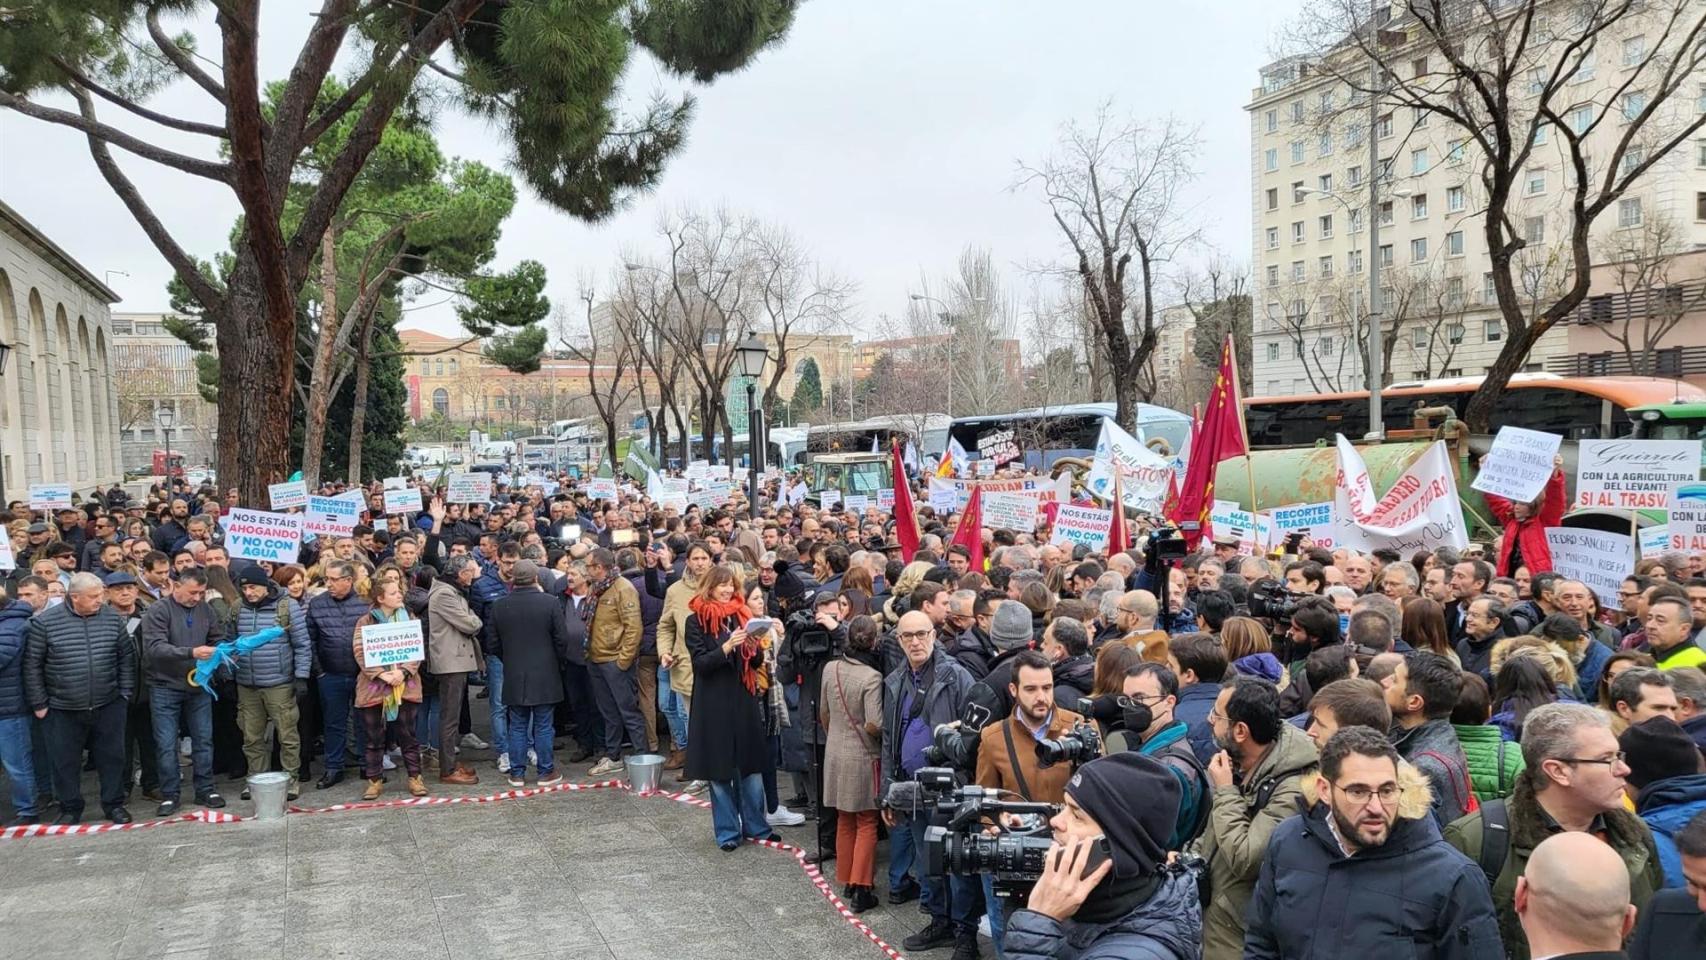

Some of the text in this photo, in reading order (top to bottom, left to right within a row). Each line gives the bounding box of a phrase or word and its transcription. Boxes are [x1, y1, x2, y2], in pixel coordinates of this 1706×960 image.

[1582, 472, 1694, 481] CON LA AGRICULTURA
[1024, 480, 1036, 490] EL
[1604, 482, 1621, 490] DEL
[311, 498, 356, 508] RECORTES
[1581, 492, 1668, 507] SI AL TRASV
[312, 505, 355, 515] TRASVASE
[1061, 509, 1080, 518] NOS
[1276, 505, 1330, 520] RECORTES
[233, 513, 297, 528] NOS ESTÁIS
[1276, 515, 1330, 529] TRASVASE
[1672, 512, 1693, 521] CON
[1057, 518, 1109, 531] AHOGANDO
[229, 523, 299, 539] AHOGANDO
[1067, 529, 1082, 538] NO
[1083, 532, 1104, 541] CON
[232, 535, 293, 550] Y NO CON
[1673, 535, 1685, 549] SI
[1691, 536, 1706, 550] AL
[242, 547, 278, 559] AGUA
[366, 639, 421, 651] AHOGANDO
[367, 636, 386, 644] NOS
[396, 647, 419, 655] CON
[381, 654, 409, 663] AGUA
